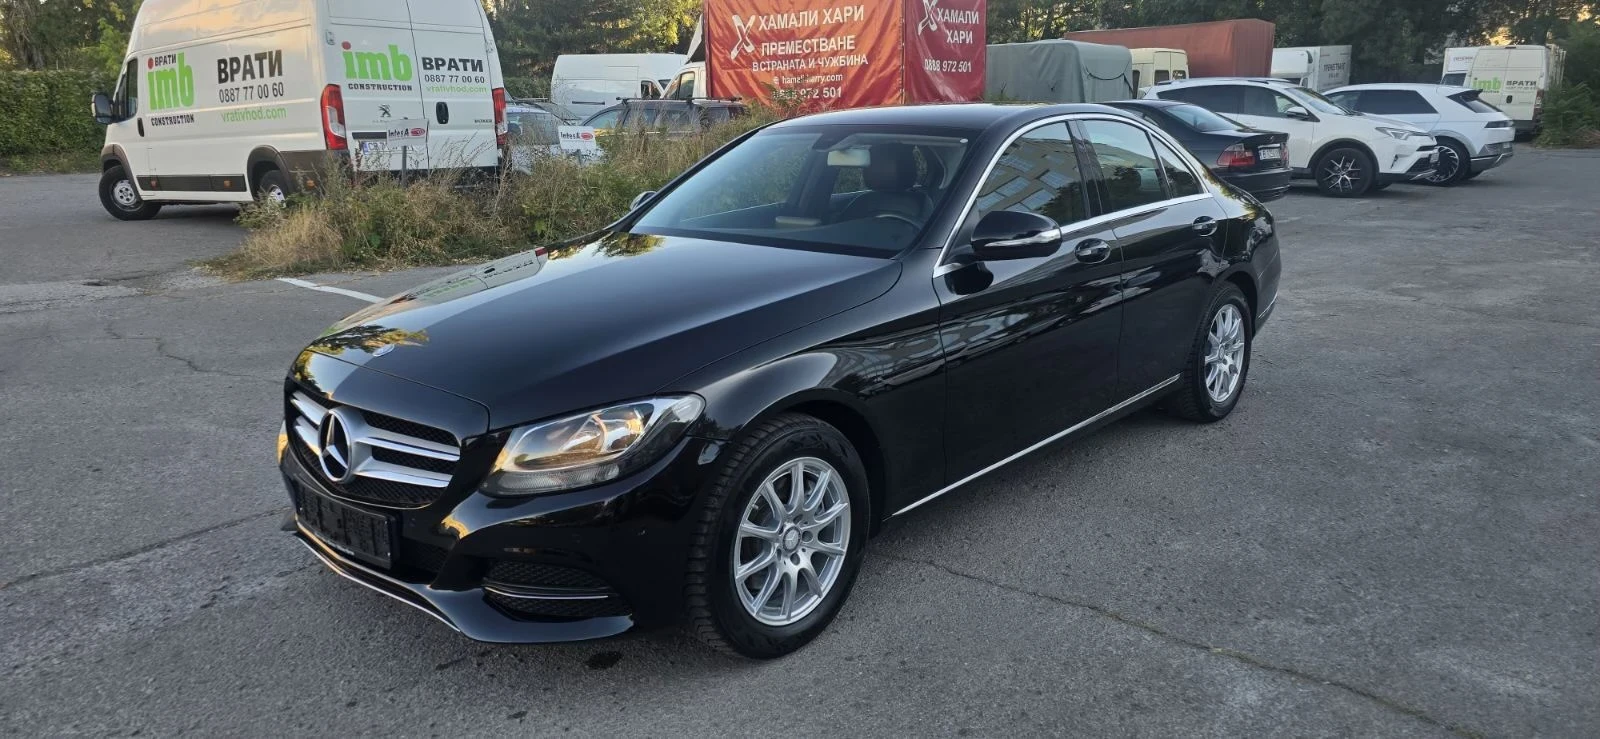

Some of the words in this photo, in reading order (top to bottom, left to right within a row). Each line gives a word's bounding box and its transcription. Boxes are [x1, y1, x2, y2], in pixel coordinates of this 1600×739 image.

[758, 10, 818, 31] ХАМАЛИ
[822, 5, 865, 24] ХАРИ
[937, 8, 980, 24] ХАМАЛИ
[946, 30, 973, 44] ХАРИ
[761, 35, 856, 56] ПРЕМЕСТВАНЕ
[154, 53, 176, 67] ВРАТИ
[217, 49, 283, 84] ВРАТИ
[341, 41, 413, 81] imb
[421, 57, 484, 72] ВРАТИ
[752, 62, 759, 72] В
[760, 58, 806, 71] СТРАНАТА
[808, 58, 816, 68] И
[817, 54, 869, 67] ЧУЖБИНА
[924, 58, 941, 72] 0888
[942, 60, 957, 72] 972
[958, 61, 972, 73] 501
[147, 52, 194, 111] imb
[424, 74, 446, 83] 0887
[448, 75, 459, 83] 77
[461, 75, 472, 84] 00
[474, 75, 485, 84] 60
[1472, 77, 1500, 90] imb
[219, 87, 240, 103] 0887
[242, 85, 254, 100] 77
[257, 83, 269, 99] 00
[271, 82, 284, 97] 60
[347, 83, 413, 91] CONSTRUCTION
[822, 86, 842, 98] 501
[151, 114, 195, 126] CONSTRUCTION
[221, 106, 287, 122] vrativhod.com
